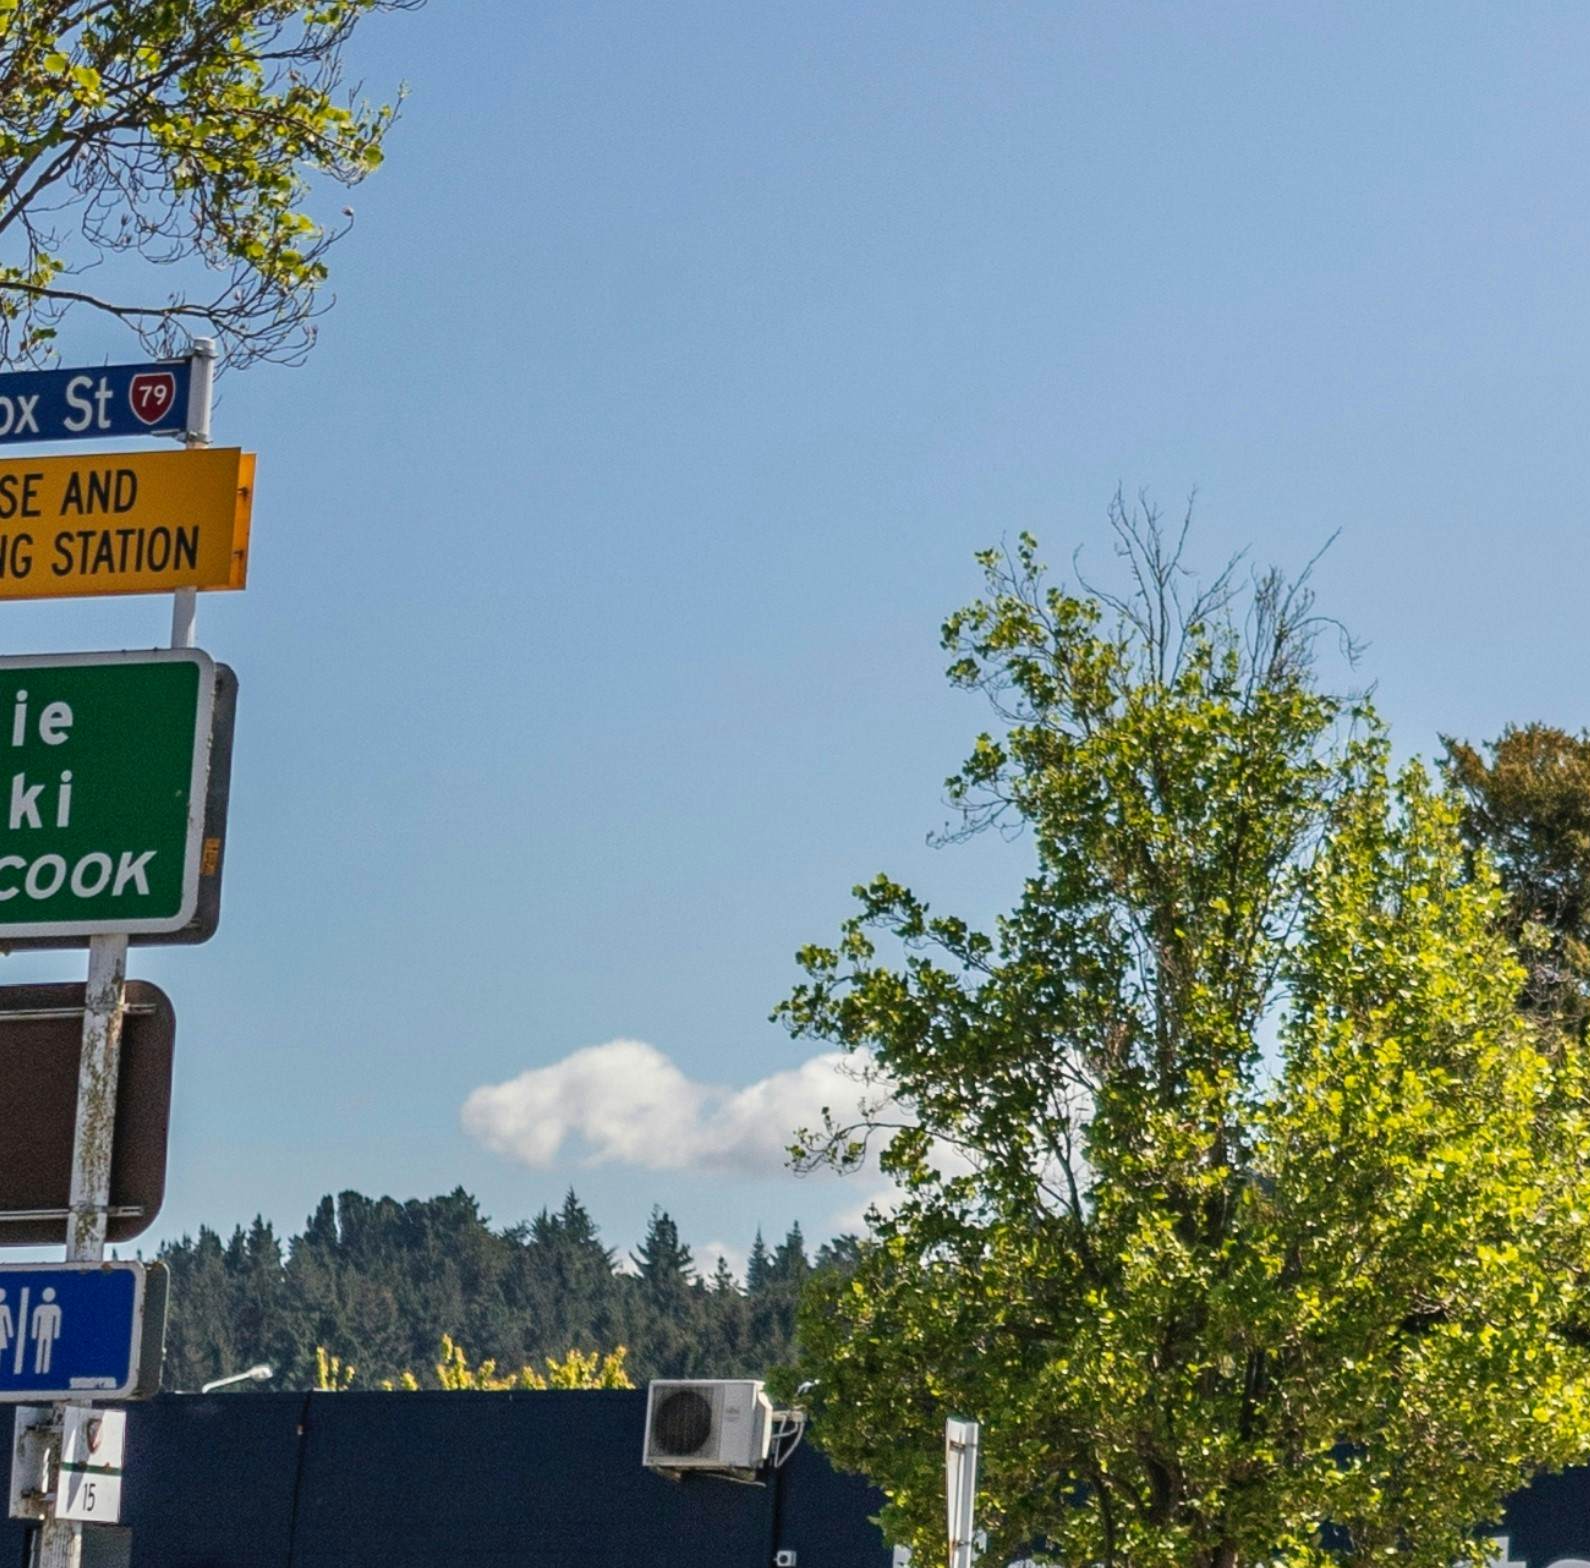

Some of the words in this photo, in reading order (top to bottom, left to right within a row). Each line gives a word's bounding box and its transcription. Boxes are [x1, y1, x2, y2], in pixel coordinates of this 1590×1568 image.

[63, 376, 113, 432] St
[138, 385, 167, 407] 79
[60, 469, 138, 516] AND
[0, 533, 33, 578] G
[51, 525, 199, 577] STATION
[0, 851, 157, 901] COOK
